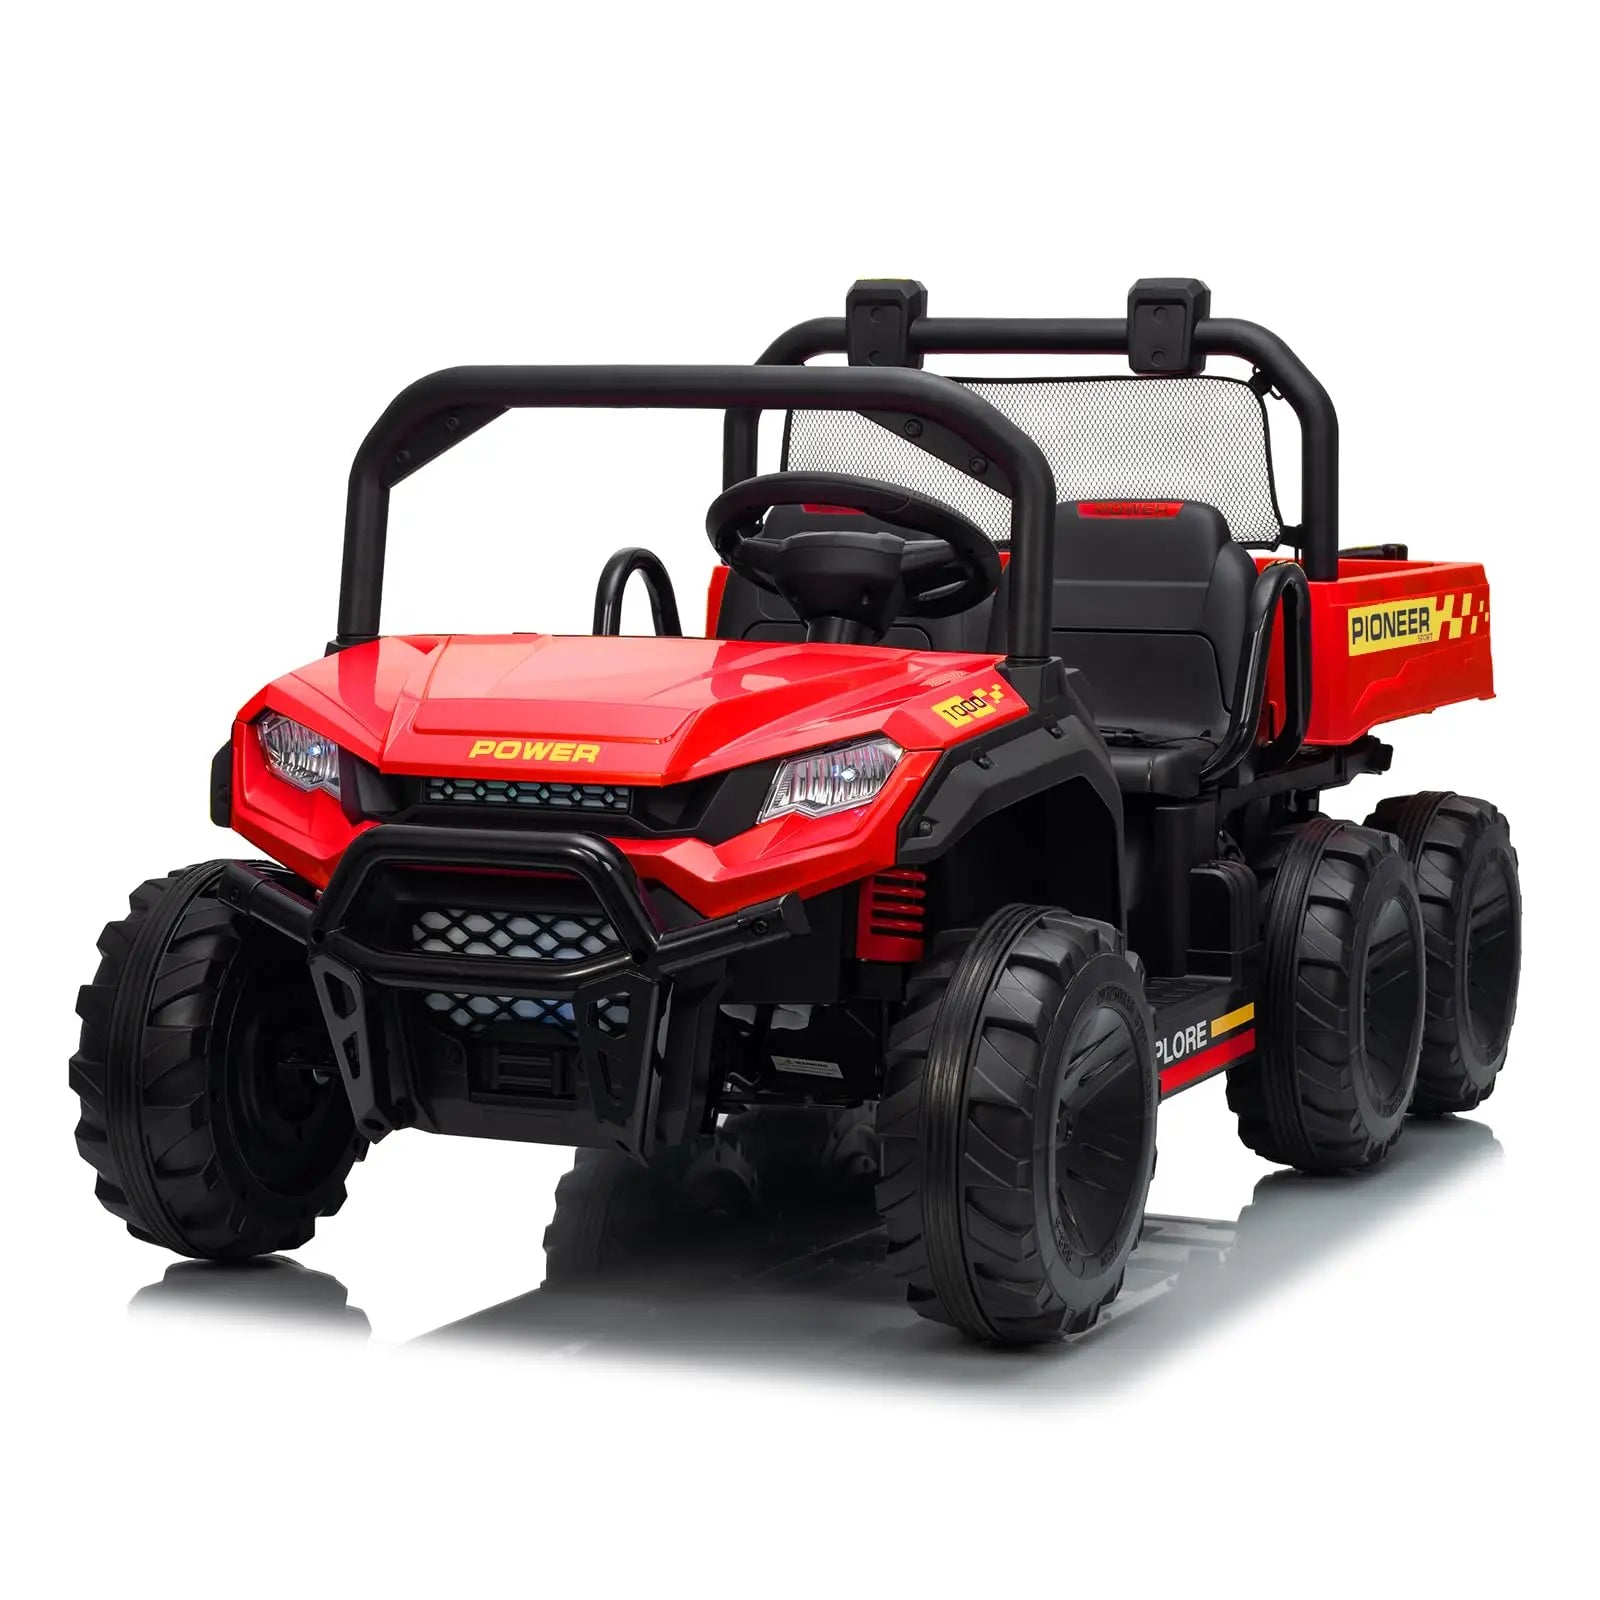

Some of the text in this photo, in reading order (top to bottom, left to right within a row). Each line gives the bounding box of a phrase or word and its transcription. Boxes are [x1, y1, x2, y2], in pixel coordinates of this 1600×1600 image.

[1352, 606, 1430, 645] PIONEER
[942, 695, 988, 720] 1000
[468, 740, 600, 763] POWER
